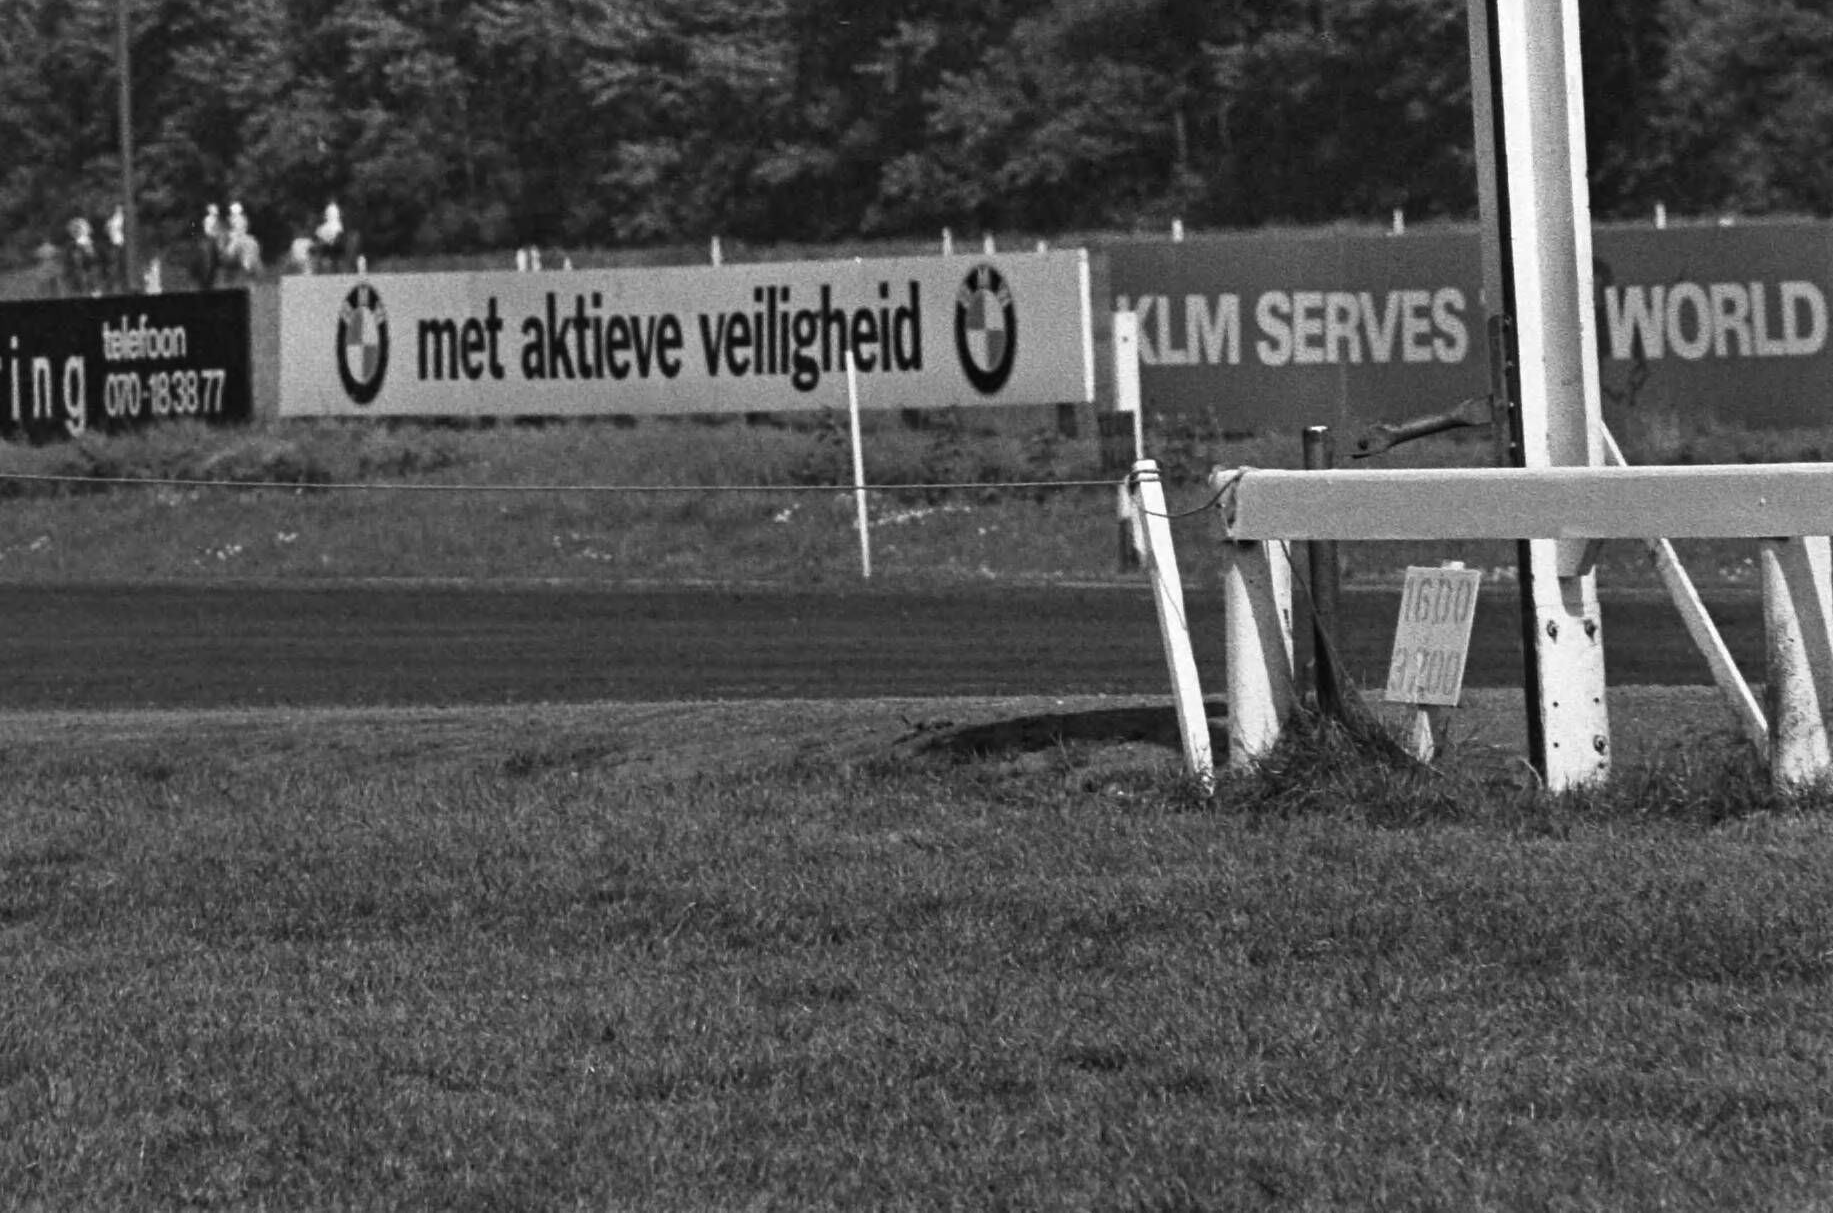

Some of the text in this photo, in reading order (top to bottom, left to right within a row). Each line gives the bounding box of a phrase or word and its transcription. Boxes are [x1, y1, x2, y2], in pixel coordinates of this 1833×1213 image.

[101, 313, 187, 361] telefoon
[417, 295, 506, 382] met
[520, 290, 684, 381] aktieve
[698, 279, 924, 394] veiligheid
[1255, 287, 1468, 367] SERVES
[1606, 280, 1829, 360] WORLD
[1404, 575, 1472, 625] 1600
